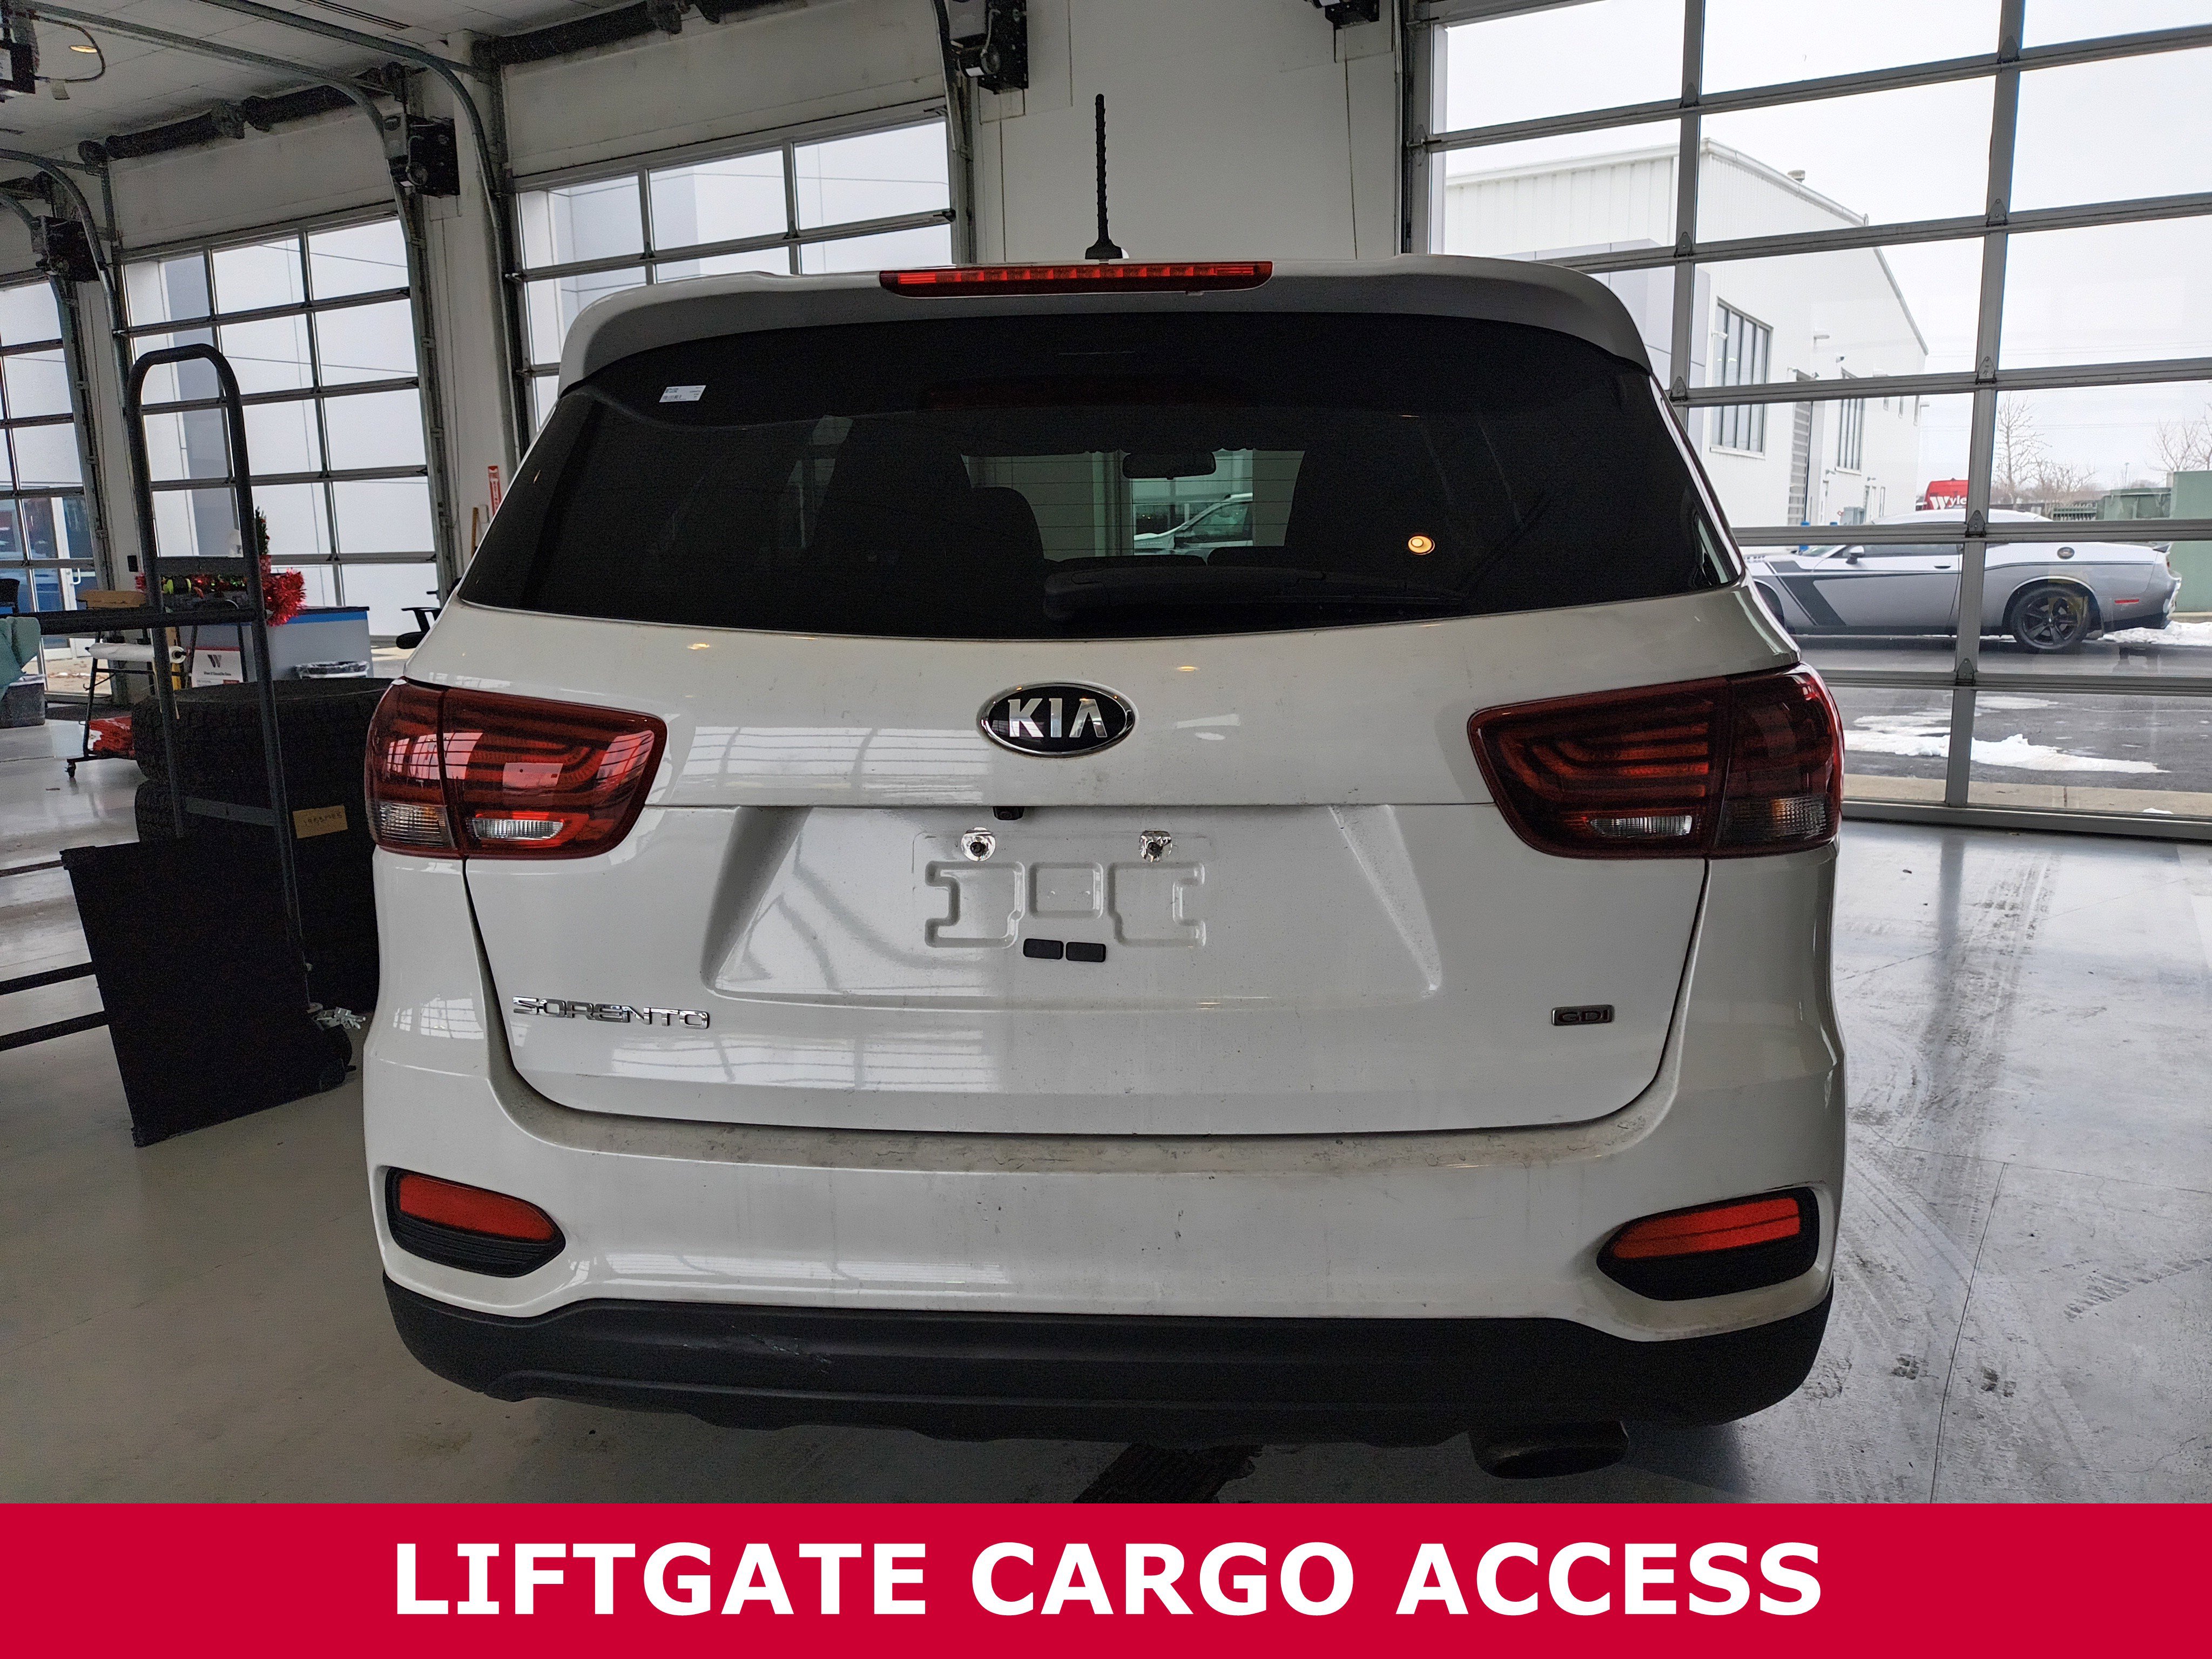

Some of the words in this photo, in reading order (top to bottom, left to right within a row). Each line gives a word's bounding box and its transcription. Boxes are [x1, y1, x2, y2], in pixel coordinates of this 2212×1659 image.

[1930, 495, 1967, 510] Wyle
[1008, 698, 1108, 738] KIA
[512, 995, 710, 1029] SORENTO
[1557, 1009, 1609, 1023] GDI
